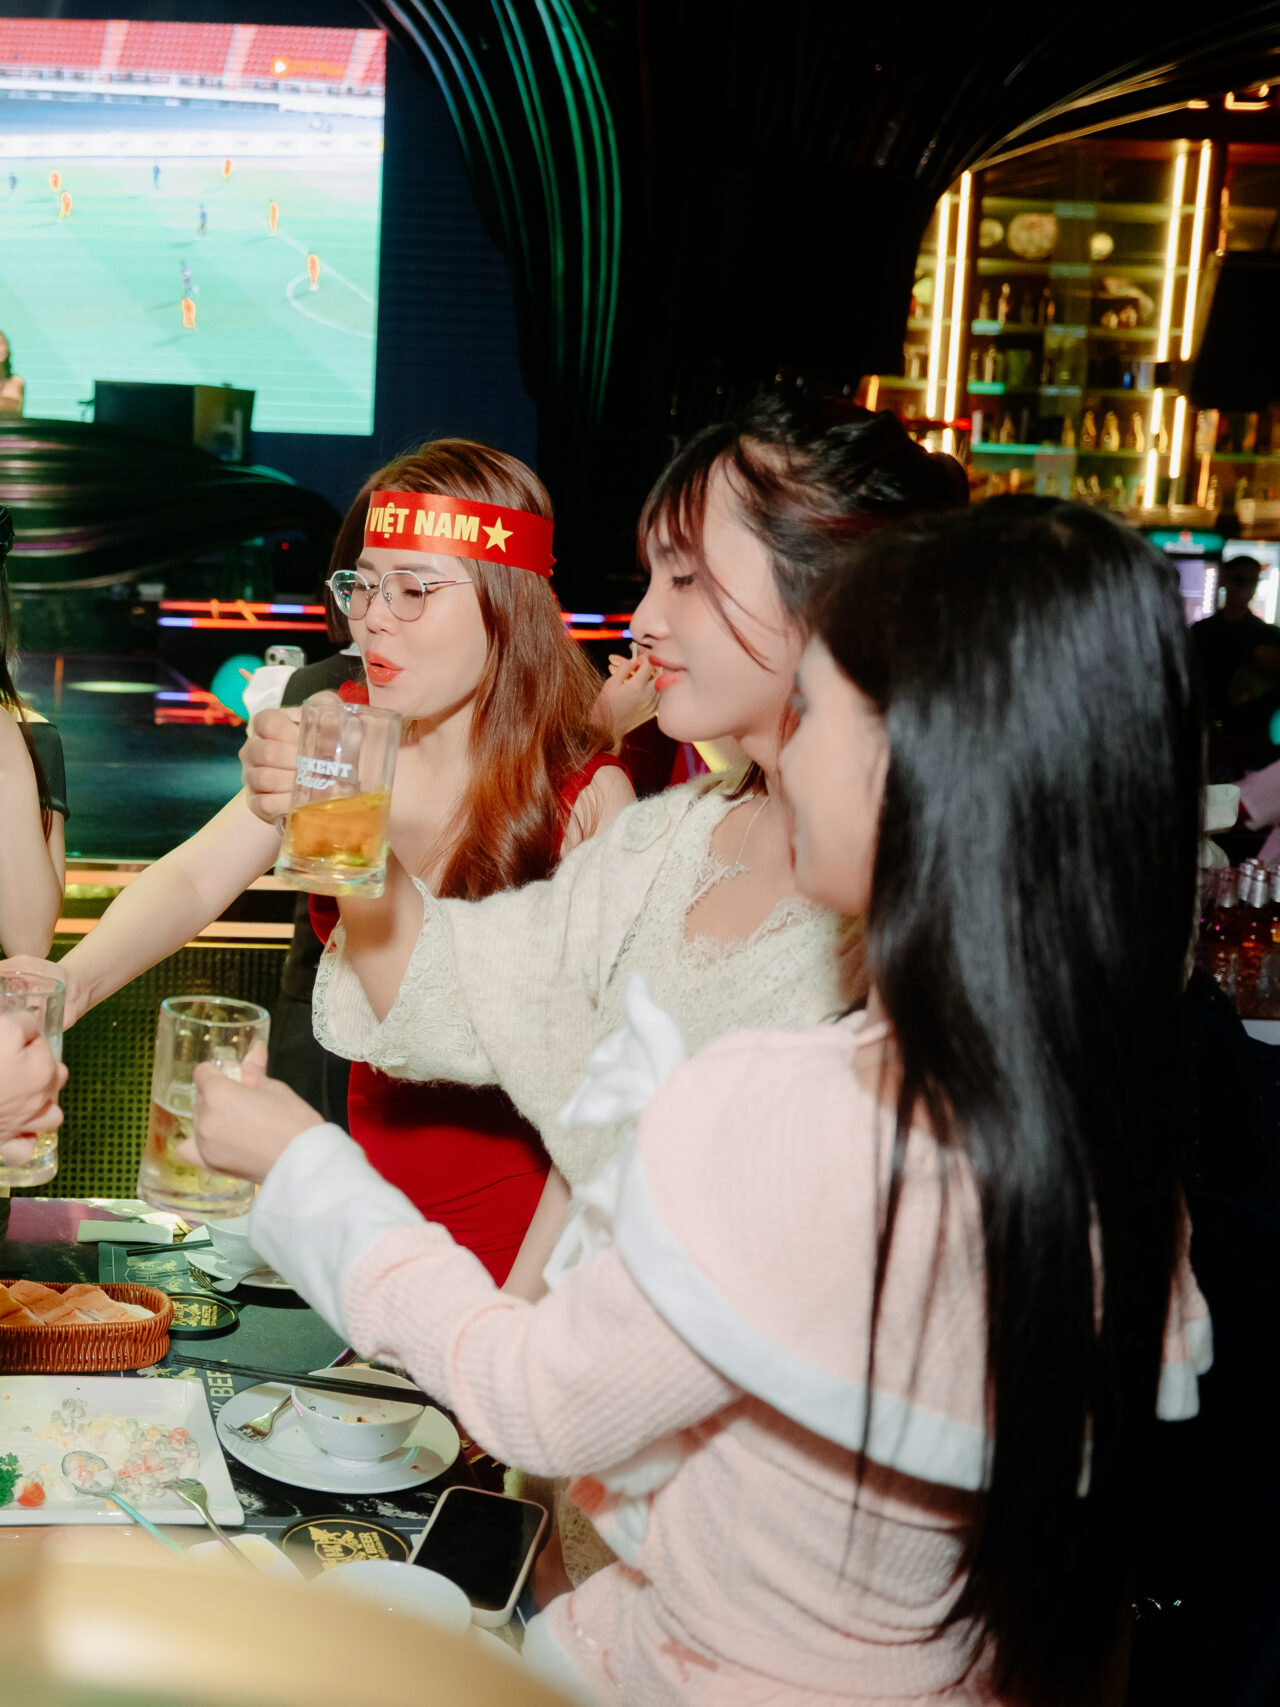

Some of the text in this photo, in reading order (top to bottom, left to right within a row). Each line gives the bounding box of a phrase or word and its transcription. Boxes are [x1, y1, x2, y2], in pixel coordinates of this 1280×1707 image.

[369, 502, 480, 543] VIỆT NAM
[206, 1358, 235, 1397] BEE
